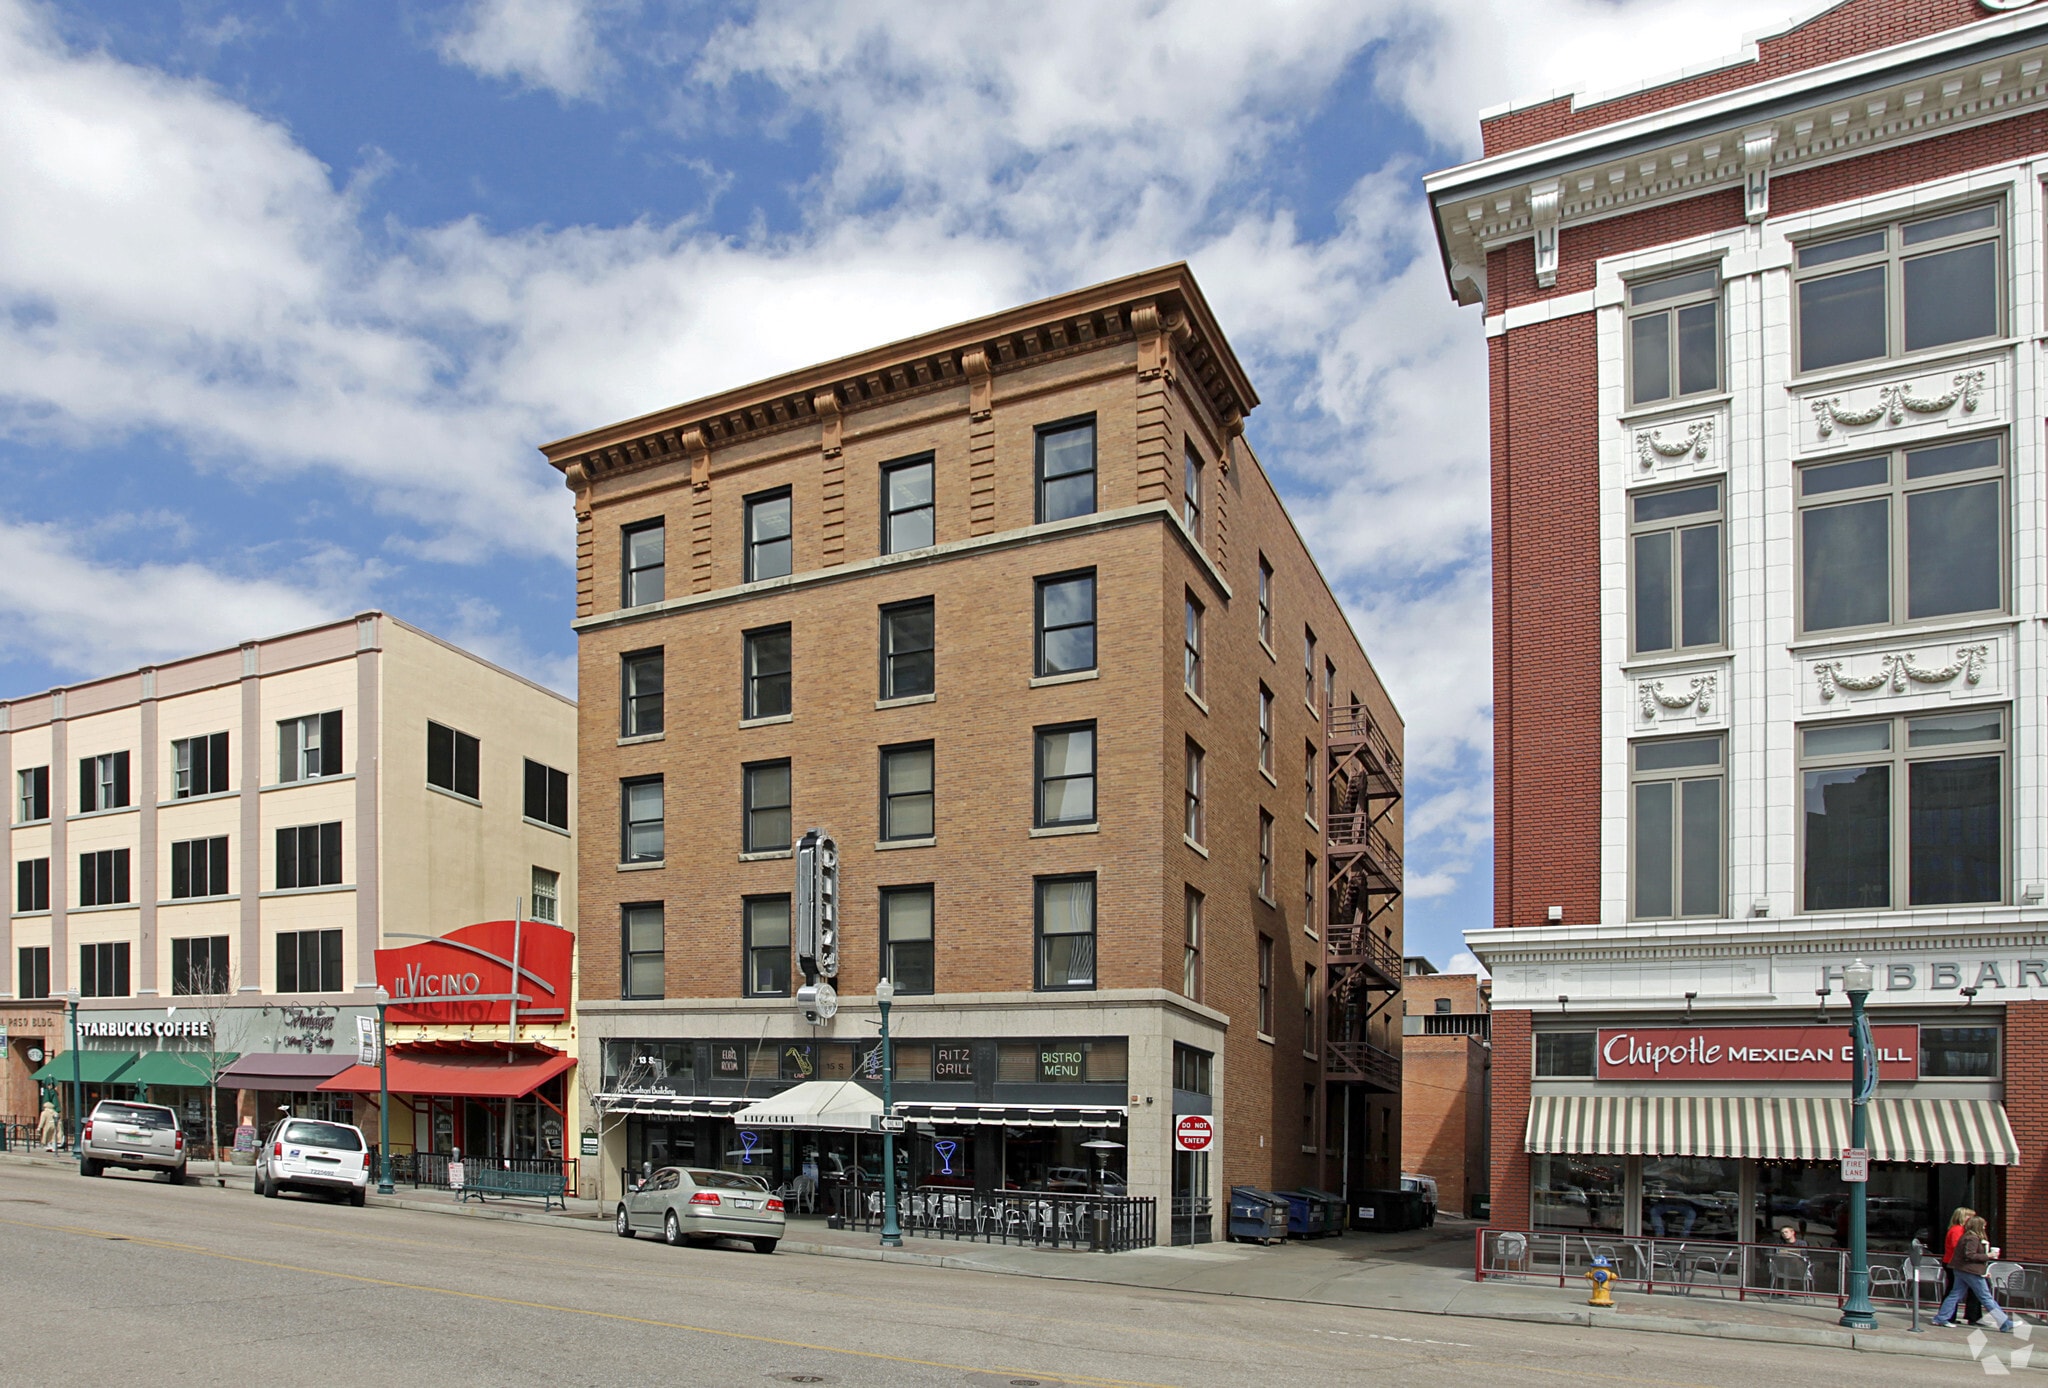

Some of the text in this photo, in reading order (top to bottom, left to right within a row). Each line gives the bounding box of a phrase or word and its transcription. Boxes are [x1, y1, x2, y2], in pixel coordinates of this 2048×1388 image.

[1822, 959, 2048, 991] HBBAR
[8, 1018, 28, 1027] PASO
[32, 1017, 55, 1027] BLDG.
[76, 1021, 208, 1036] STARBUCKS COFFEE
[938, 1049, 970, 1061] RITZ
[1041, 1052, 1082, 1063] BISTRO
[1603, 1034, 1912, 1073] Chipotle MEXICAN GILL
[639, 1056, 647, 1064] 13
[936, 1063, 972, 1075] GRILL
[1044, 1065, 1079, 1077] MENU
[617, 1085, 627, 1094] The
[651, 1084, 677, 1097] Building
[1846, 1160, 1862, 1168] FIRE
[1845, 1169, 1863, 1177] LANE
